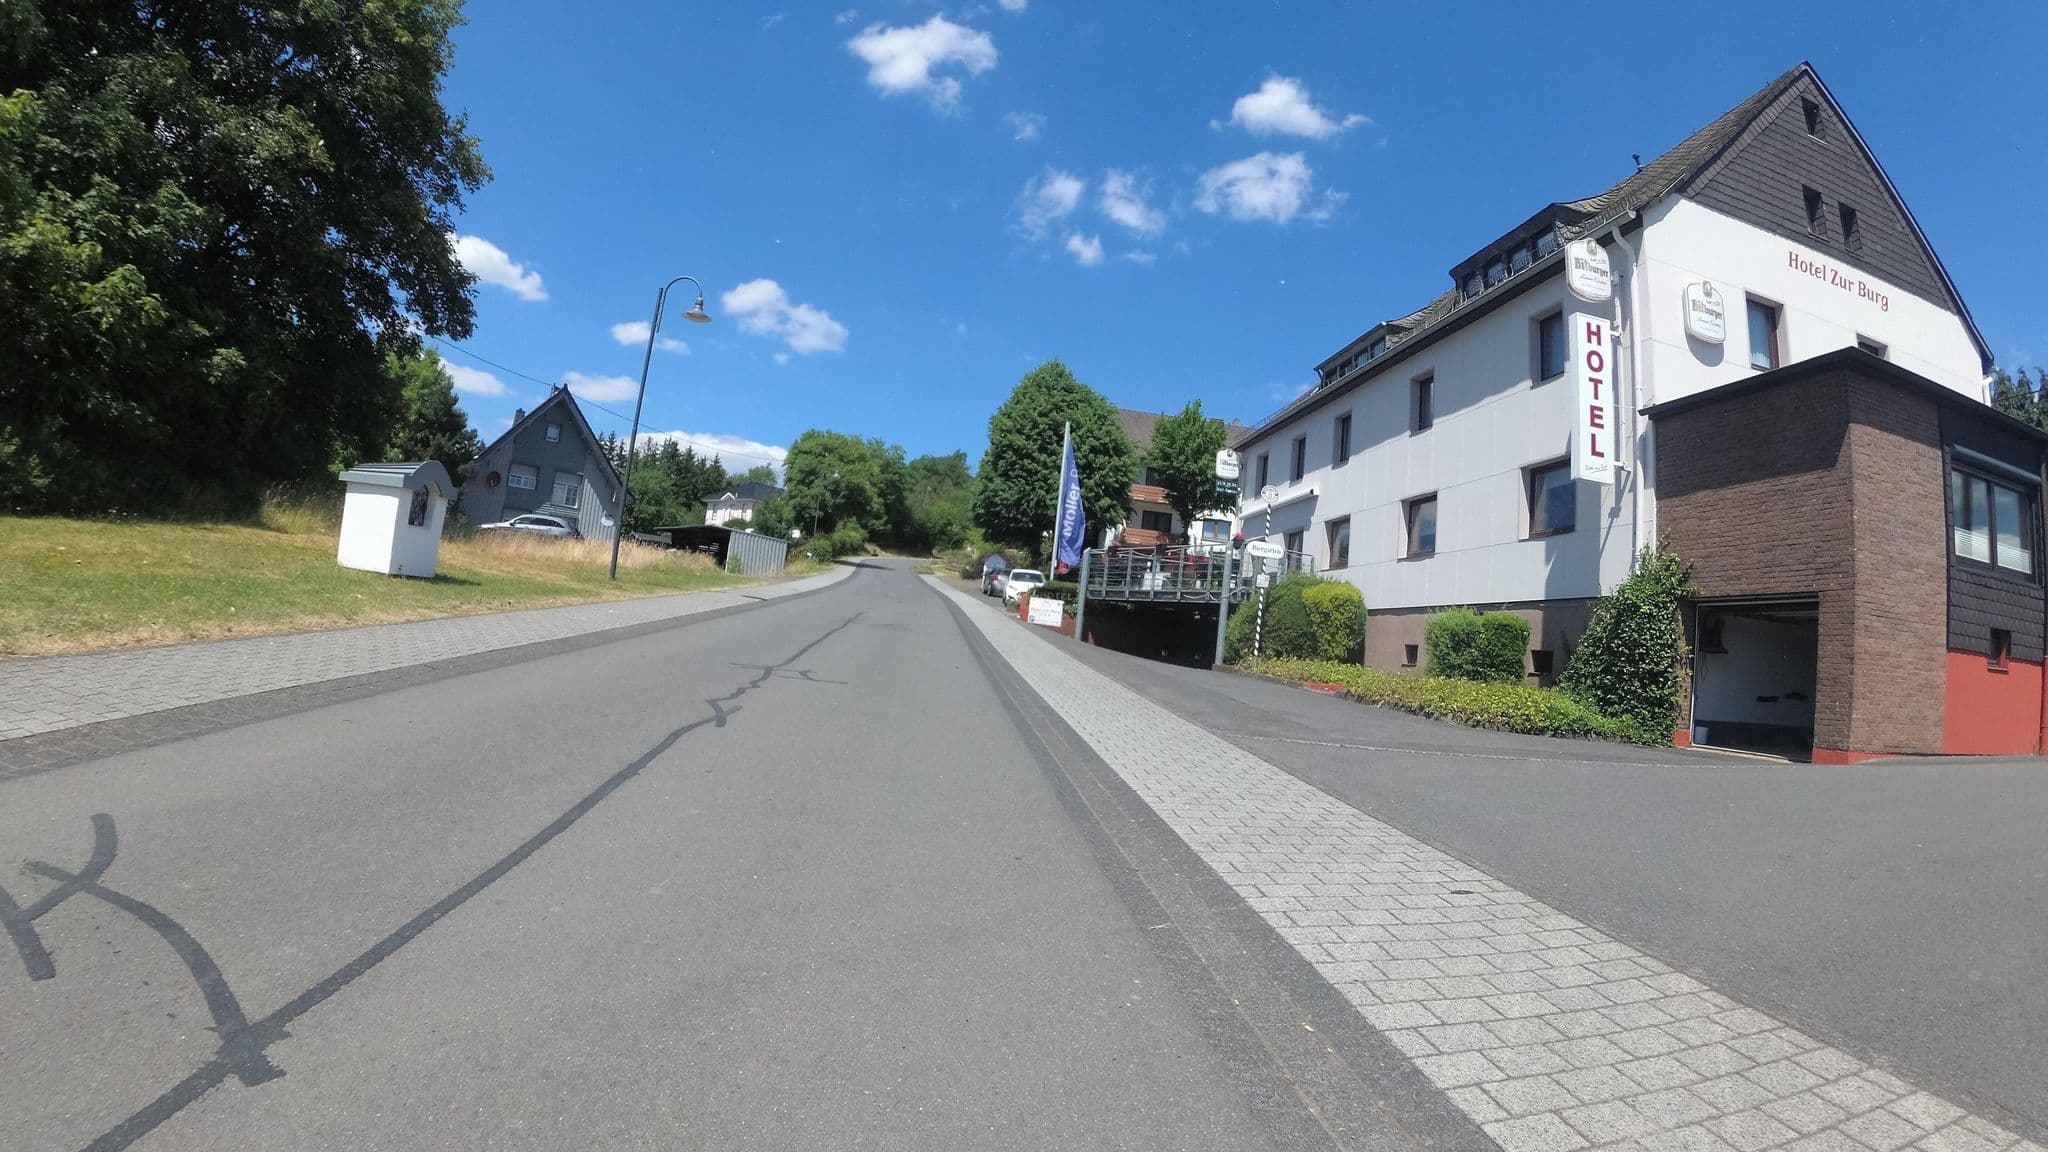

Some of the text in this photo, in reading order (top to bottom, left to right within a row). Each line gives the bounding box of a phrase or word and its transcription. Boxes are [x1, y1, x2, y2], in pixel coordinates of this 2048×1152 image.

[1574, 256, 1609, 278] Bitburger
[1788, 251, 1889, 312] Hotel Zur Burg
[1691, 298, 1723, 320] Bitburger
[1586, 321, 1605, 459] HOTEL
[1252, 544, 1282, 555] Biergarten
